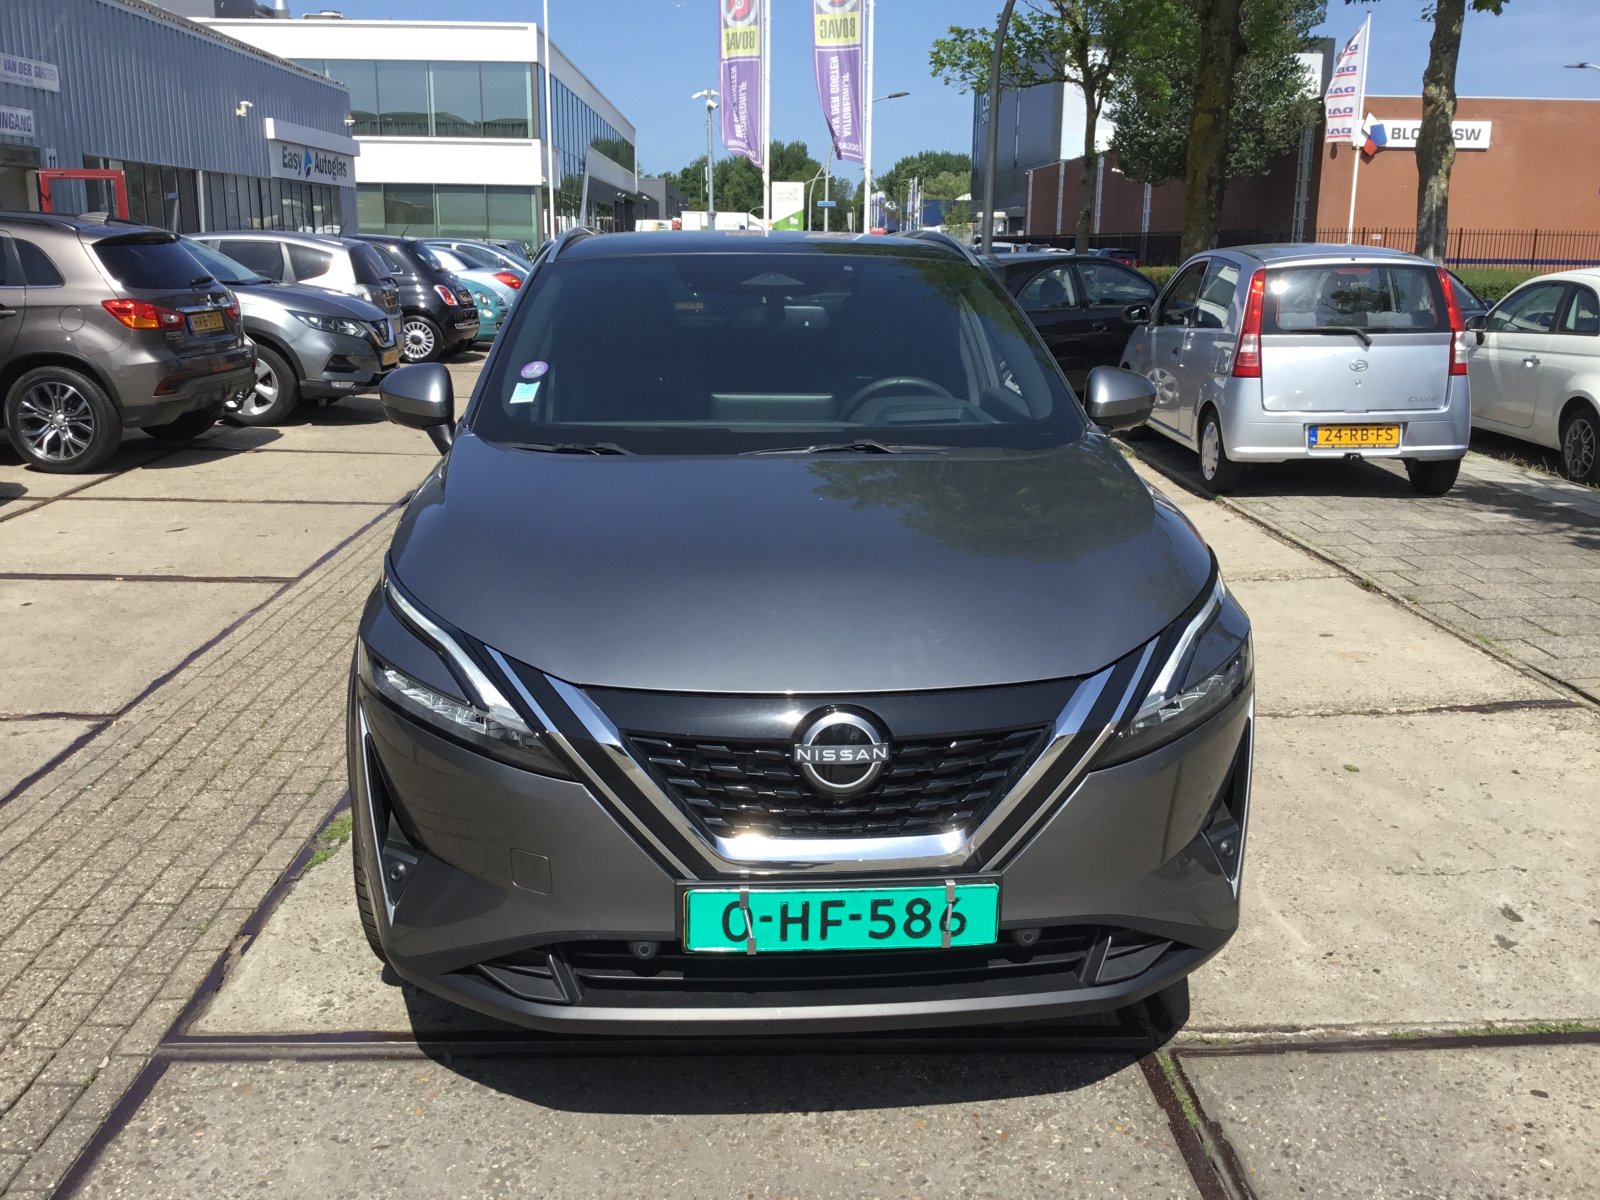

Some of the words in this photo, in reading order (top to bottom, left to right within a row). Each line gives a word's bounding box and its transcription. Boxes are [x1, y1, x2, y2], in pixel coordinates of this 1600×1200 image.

[3, 58, 17, 73] VAN
[18, 61, 33, 77] DER
[1391, 127, 1420, 141] BLO
[1453, 128, 1482, 142] SW
[282, 145, 303, 176] Easy
[314, 152, 347, 180] Autoglas
[1324, 427, 1394, 442] 24-RB-FS
[797, 747, 887, 761] NISSAN
